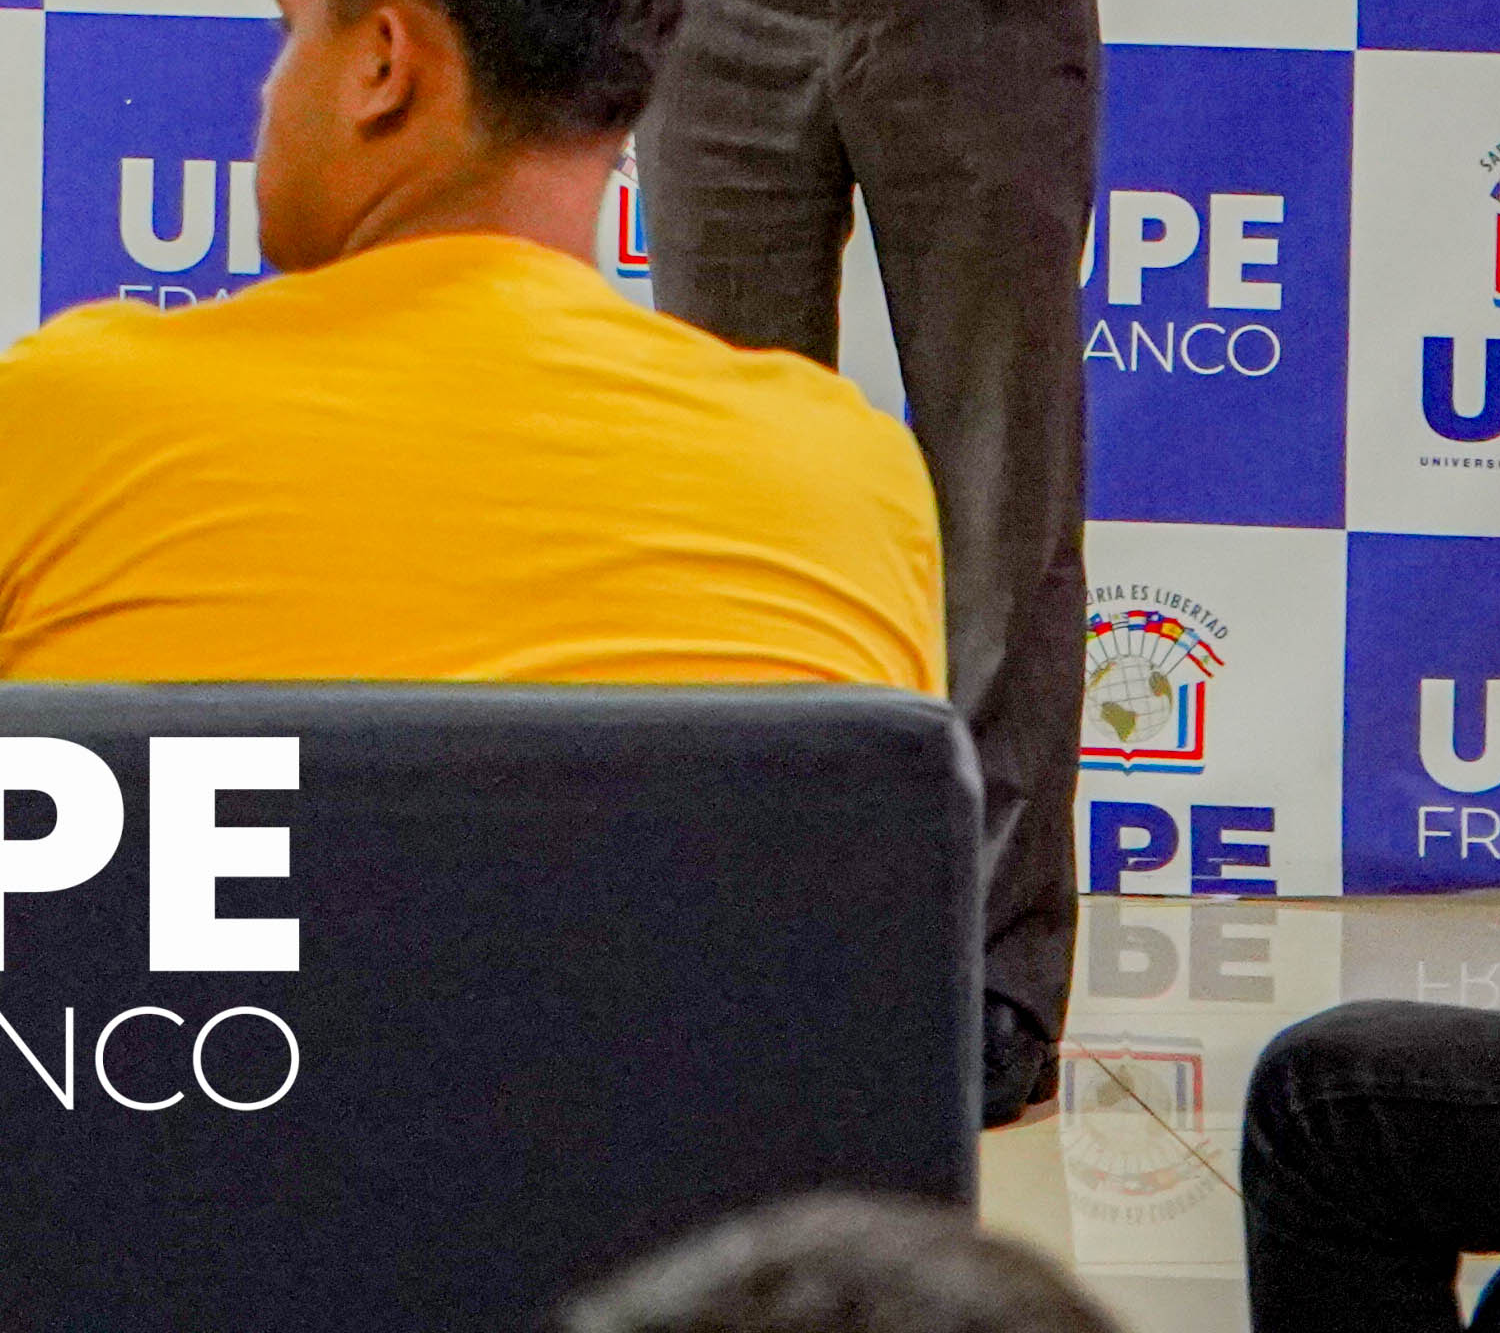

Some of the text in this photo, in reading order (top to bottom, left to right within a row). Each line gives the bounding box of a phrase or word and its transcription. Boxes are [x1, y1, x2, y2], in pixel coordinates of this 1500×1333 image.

[1081, 190, 1284, 310] PE
[1083, 319, 1281, 376] ANCO
[1090, 801, 1277, 895] PE
